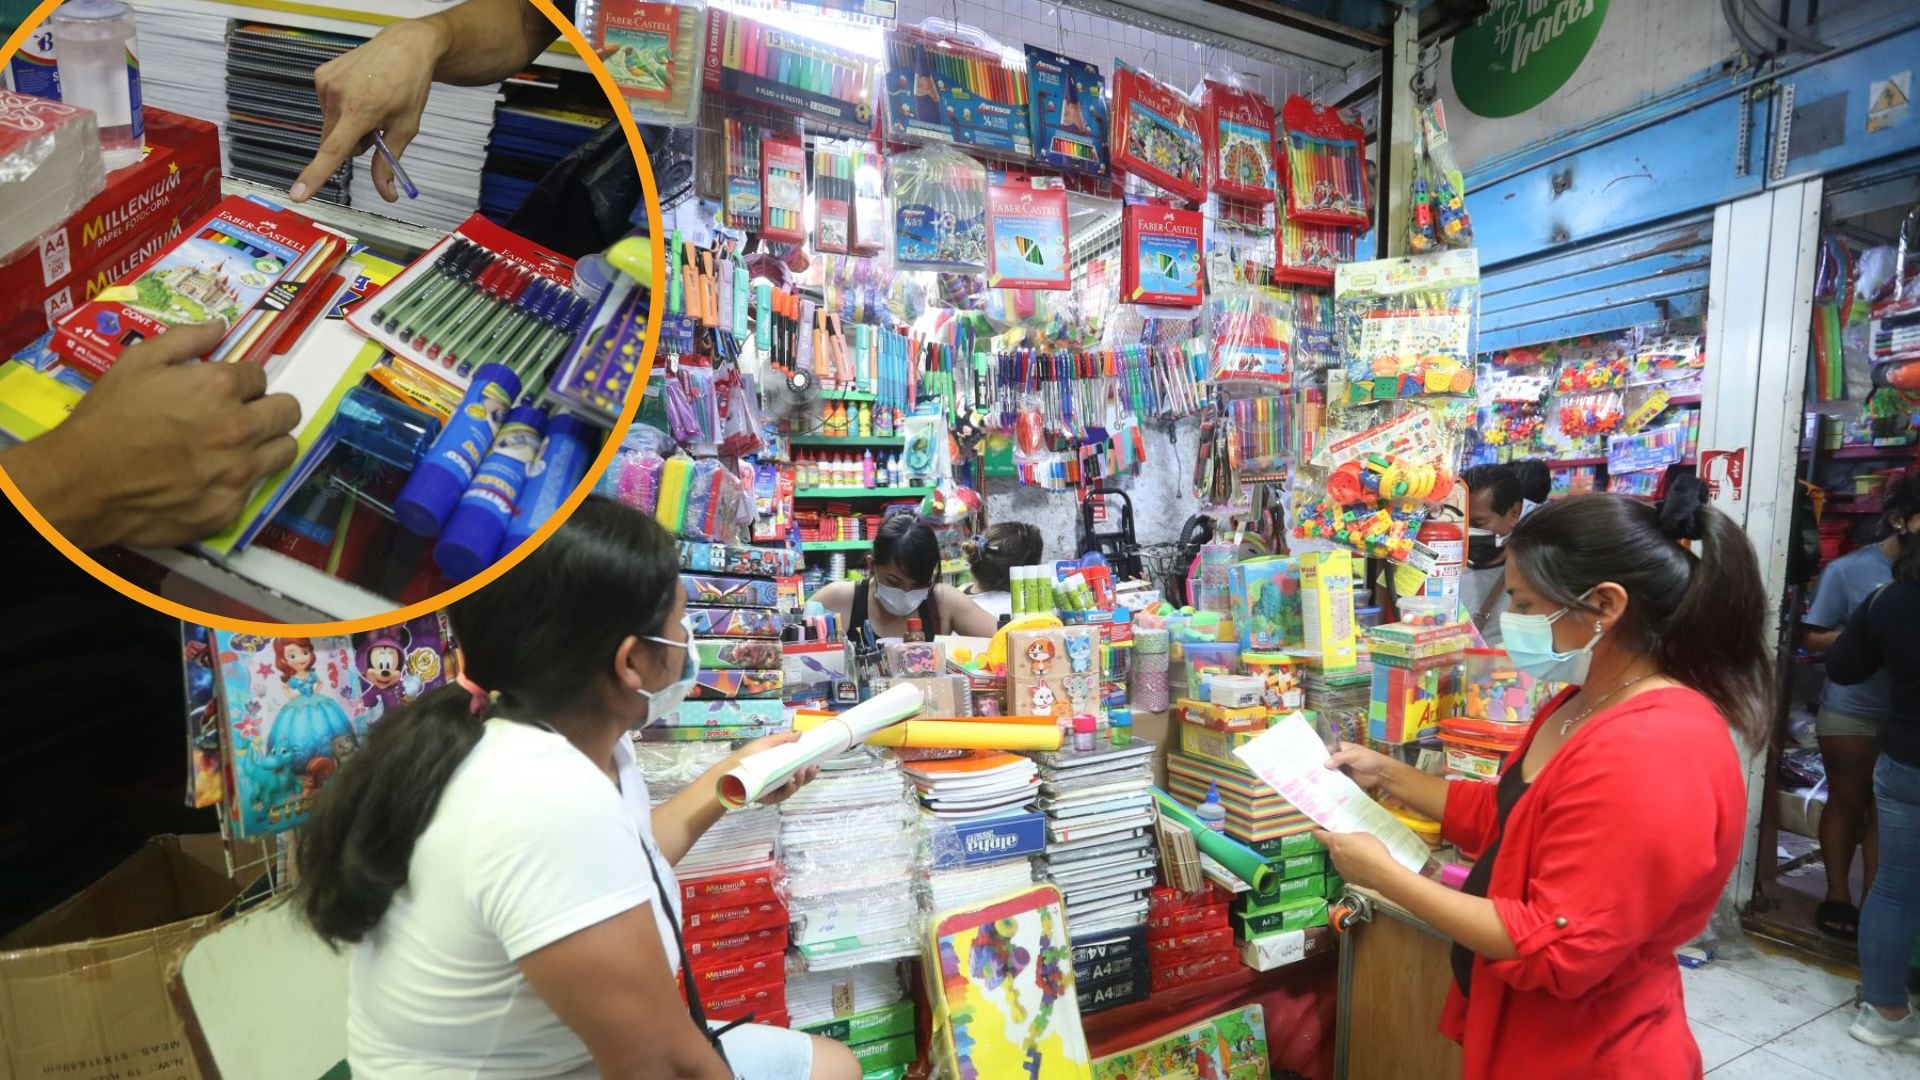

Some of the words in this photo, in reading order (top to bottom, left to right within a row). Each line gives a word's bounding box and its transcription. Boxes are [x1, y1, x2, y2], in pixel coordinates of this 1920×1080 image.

[83, 171, 181, 247] MILLENIUM
[97, 227, 123, 248] PAPEL
[125, 196, 170, 231] FOTOCOPIA
[212, 221, 226, 230] 12
[1138, 218, 1199, 236] FABER-CASTELL
[218, 210, 306, 252] FABER-CASTELL
[45, 233, 65, 257] A4
[50, 290, 68, 314] A4
[967, 834, 1017, 852] alpha
[706, 880, 746, 892] MILLENIUM
[711, 907, 750, 921] MILLENIUM
[1087, 944, 1107, 960] A4
[705, 966, 745, 980] MILLENIUM
[1093, 962, 1112, 979] A4
[1094, 986, 1113, 1003] A4
[851, 1013, 893, 1029] Standford
